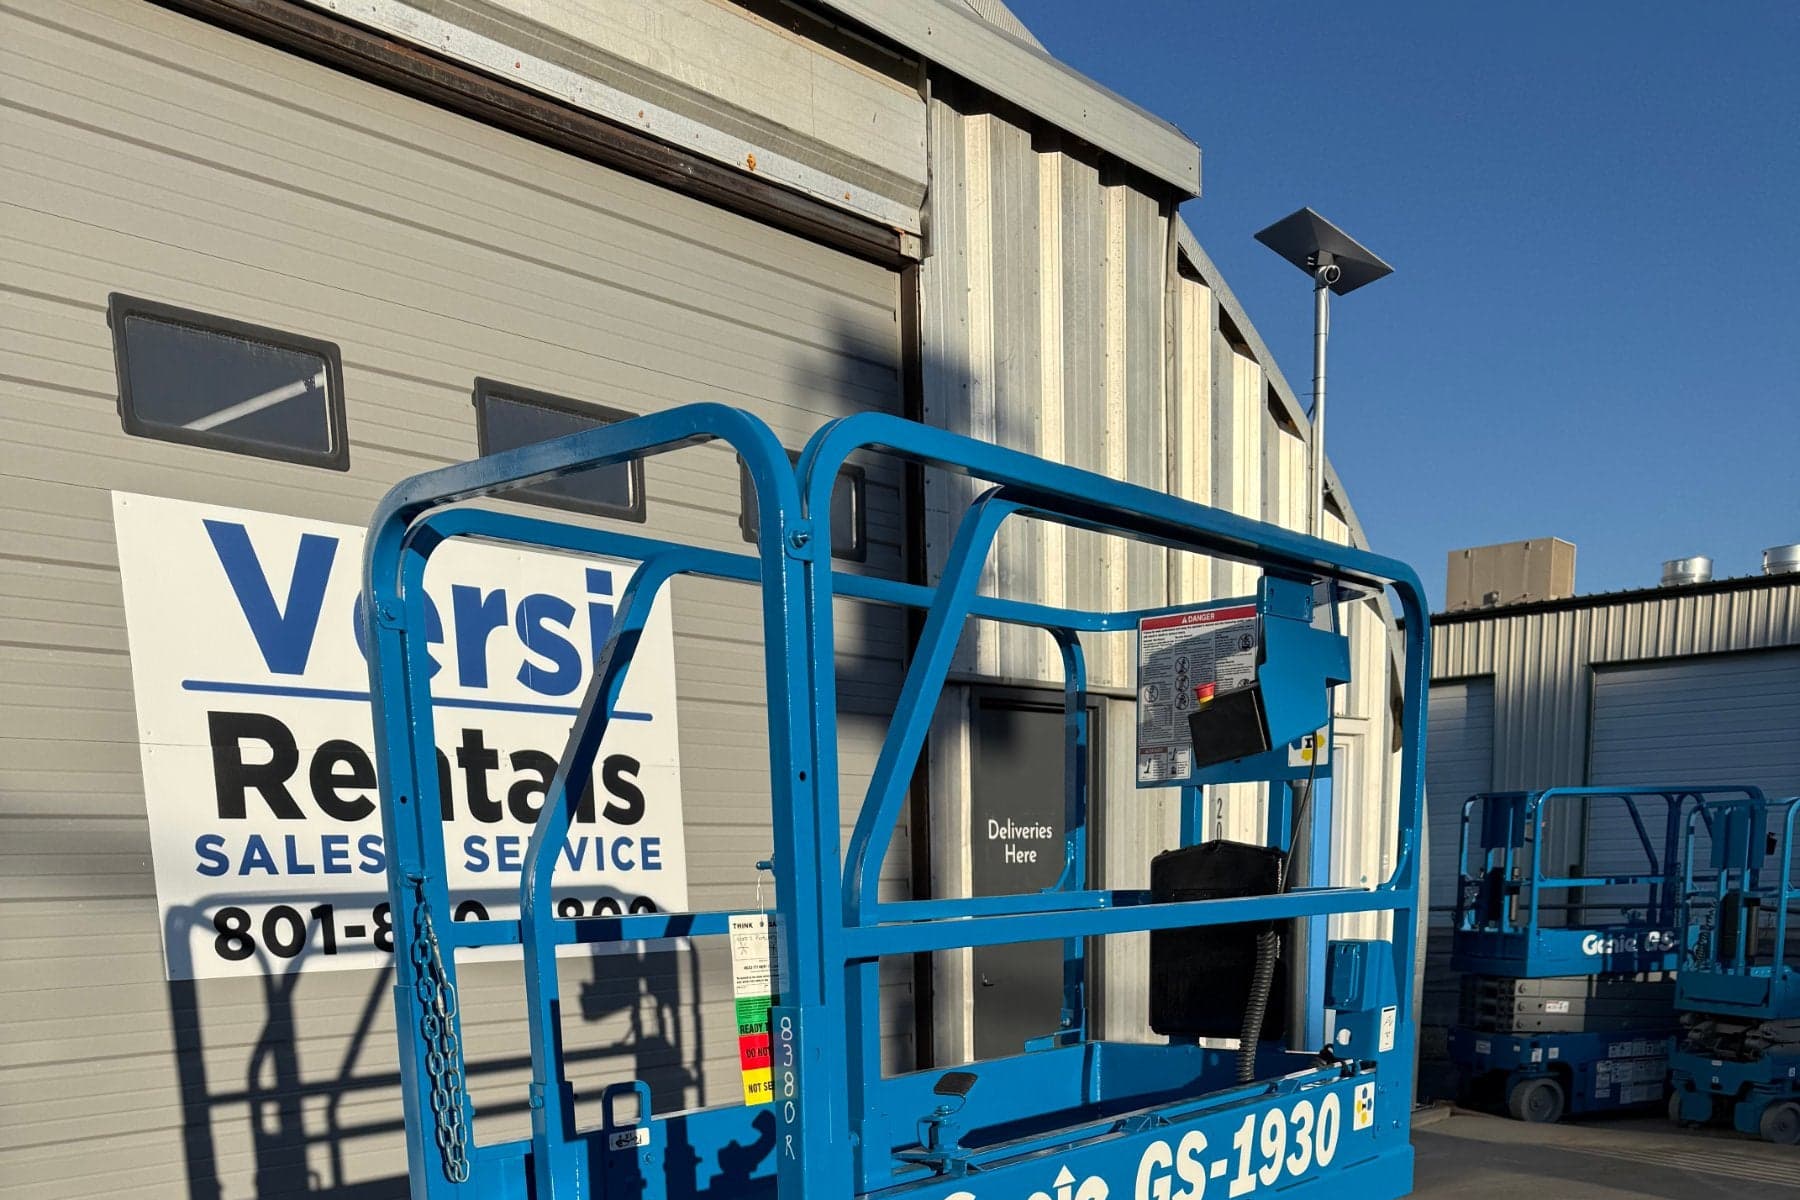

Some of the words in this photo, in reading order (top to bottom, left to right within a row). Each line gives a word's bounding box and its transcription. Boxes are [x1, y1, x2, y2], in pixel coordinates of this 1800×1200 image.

[1187, 612, 1215, 623] DANGER
[988, 817, 1053, 839] Deliveries
[195, 834, 386, 876] SALES
[463, 834, 663, 872] SEVICE
[1005, 843, 1038, 863] Here
[1582, 933, 1638, 955] Genie
[739, 1022, 763, 1034] READY
[748, 1083, 761, 1094] NOT
